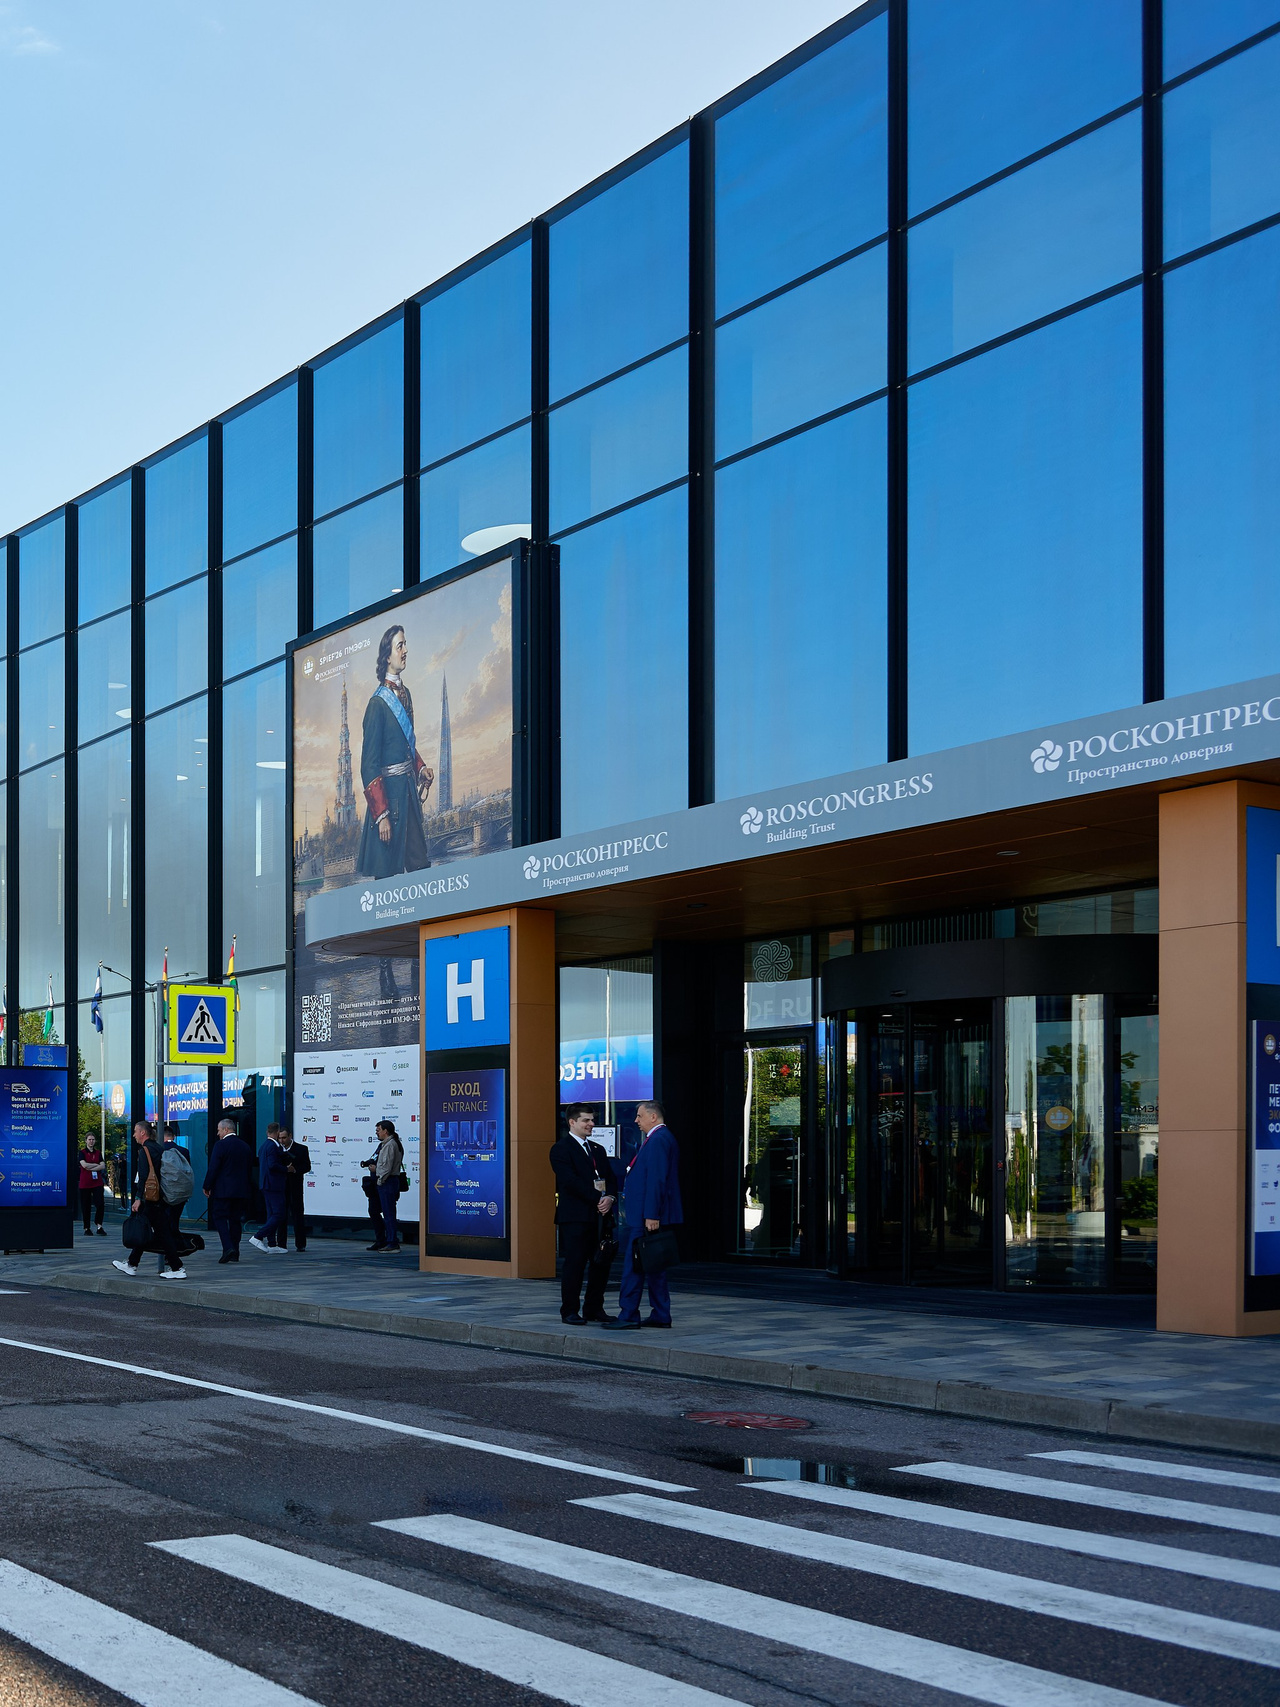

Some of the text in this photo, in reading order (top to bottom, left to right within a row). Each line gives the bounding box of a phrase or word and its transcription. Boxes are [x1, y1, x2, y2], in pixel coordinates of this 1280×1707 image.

[1067, 696, 1280, 763] РОСКОНГРЕС
[1067, 742, 1233, 785] Пространство доверия
[766, 773, 934, 827] ROSCONGRESS
[766, 822, 836, 843] Building Trust
[542, 831, 668, 873] РОСКОНГРЕСС
[375, 873, 470, 907] ROSCONGRESS
[542, 865, 629, 890] Пространство доверия
[375, 905, 416, 919] Building Trust
[447, 958, 485, 1024] H
[450, 1082, 481, 1097] ВХОД
[442, 1100, 488, 1113] ENTRANCE
[455, 1179, 480, 1188] ВиноГрад
[455, 1199, 487, 1209] Пресс-центр
